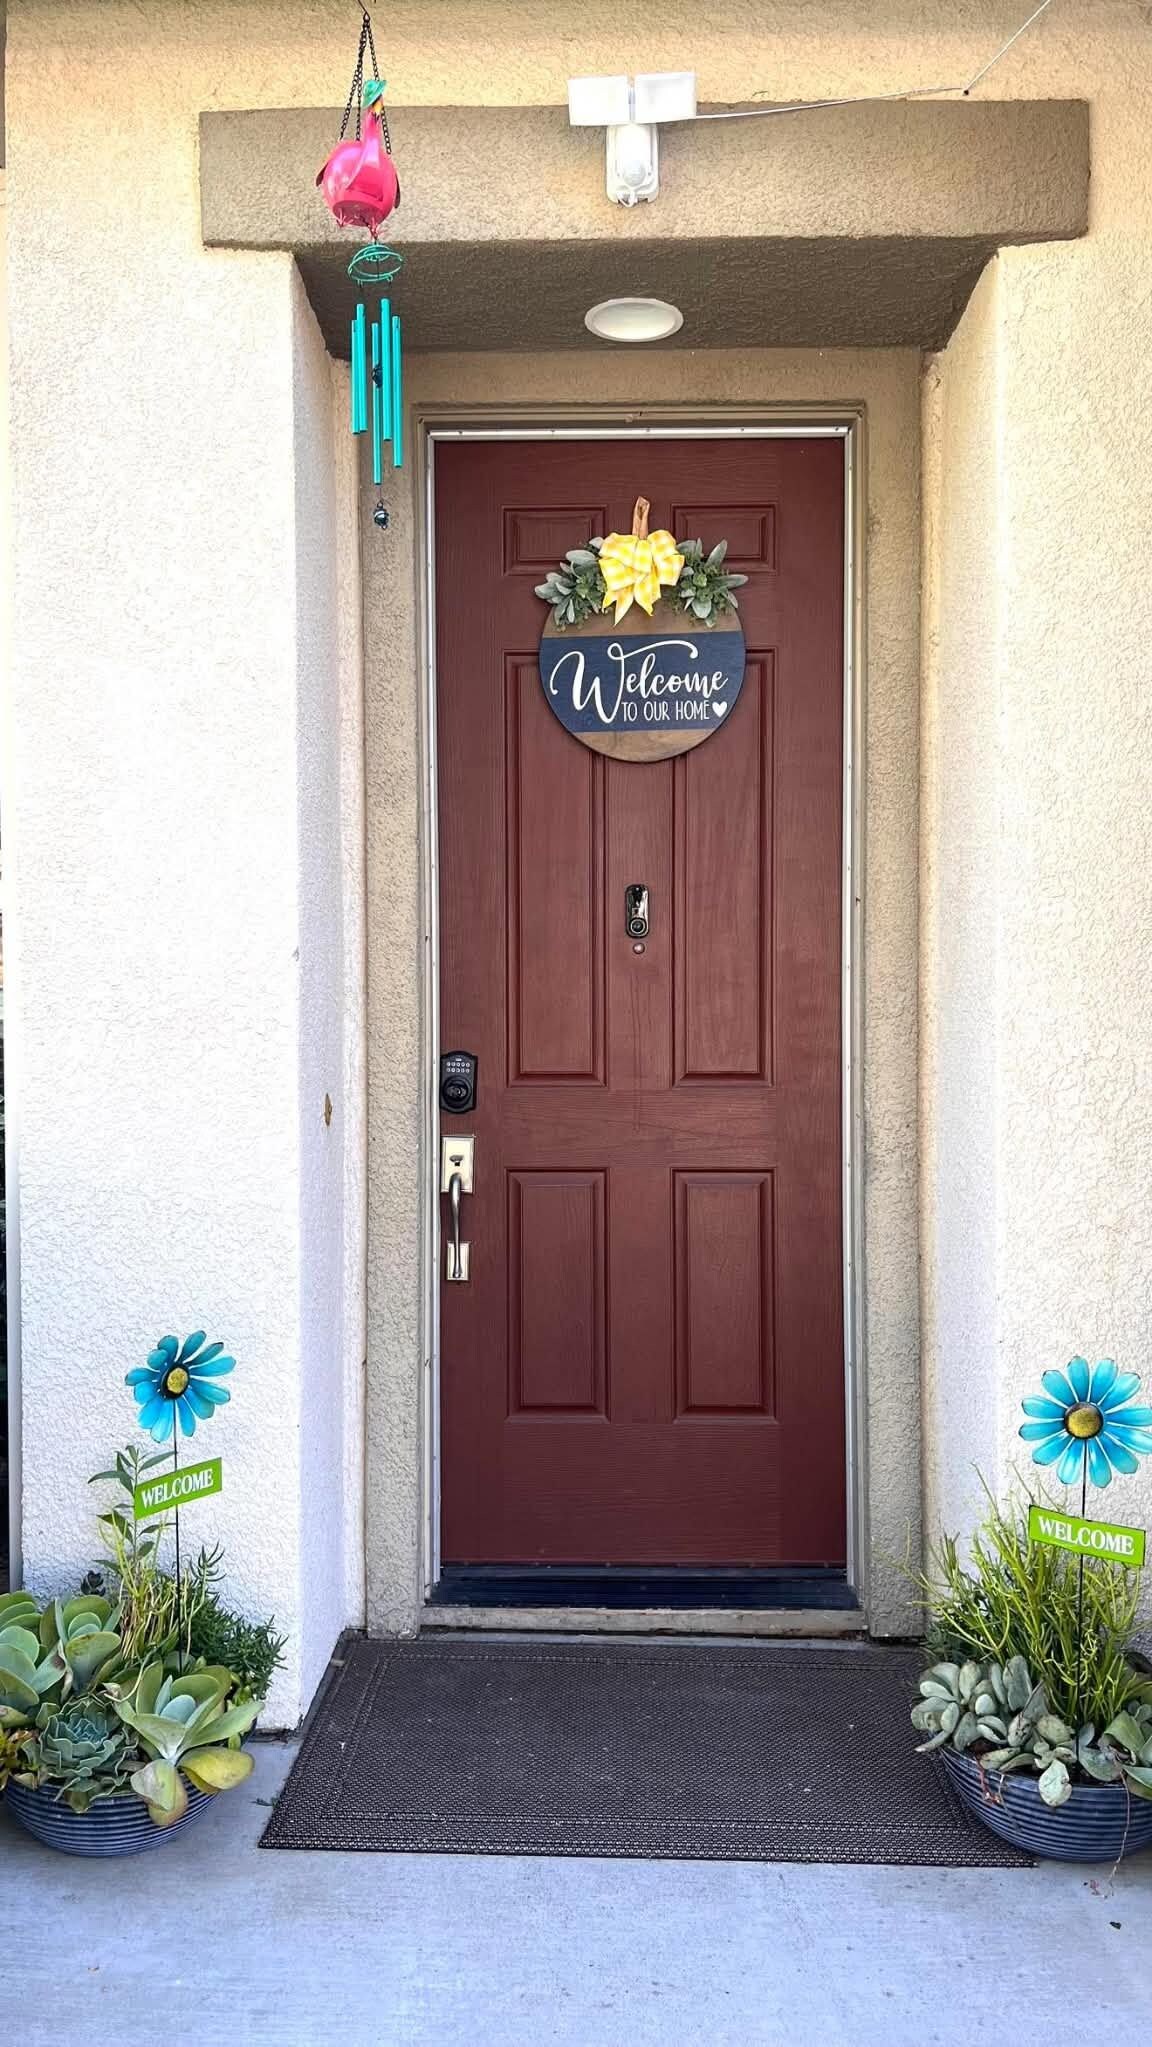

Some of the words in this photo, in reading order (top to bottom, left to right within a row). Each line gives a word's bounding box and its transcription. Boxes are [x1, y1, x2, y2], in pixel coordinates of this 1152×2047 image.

[550, 640, 728, 724] Welcome
[621, 700, 638, 722] TO
[644, 700, 670, 721] OUR
[675, 700, 710, 720] HOME
[141, 1468, 214, 1509] WELCOME
[1038, 1515, 1135, 1555] WELCOME
